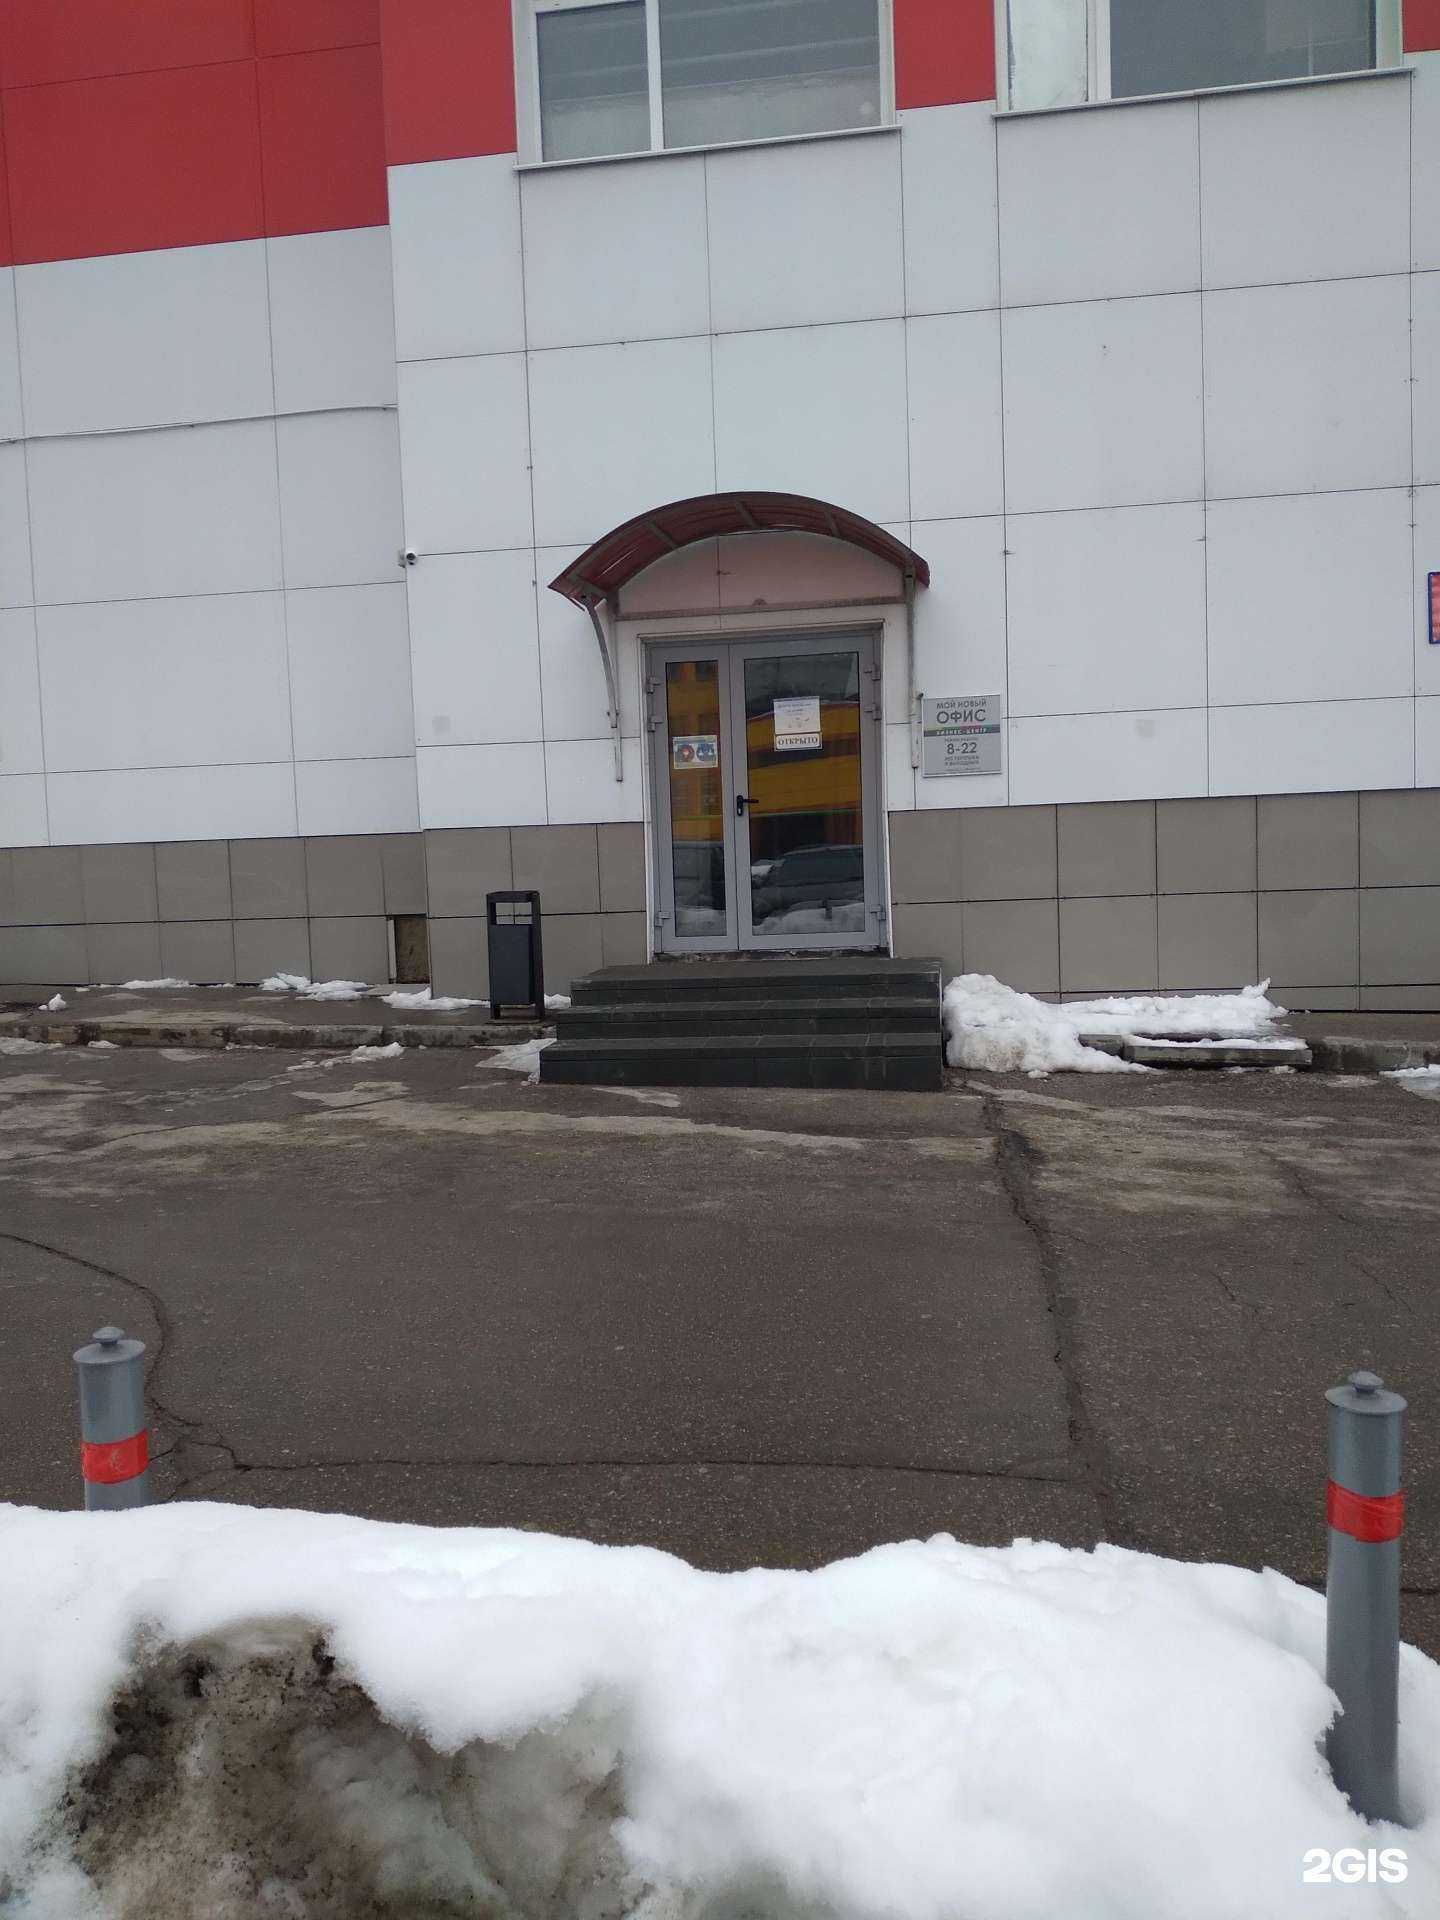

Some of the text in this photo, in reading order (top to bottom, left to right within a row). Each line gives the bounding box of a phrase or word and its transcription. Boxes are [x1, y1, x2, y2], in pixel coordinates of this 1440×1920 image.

[936, 699, 987, 709] МОЙ НОВЫЙ
[936, 709, 986, 724] ОФИС
[778, 737, 818, 746] ОТКРЫТО
[947, 742, 977, 755] 8-22
